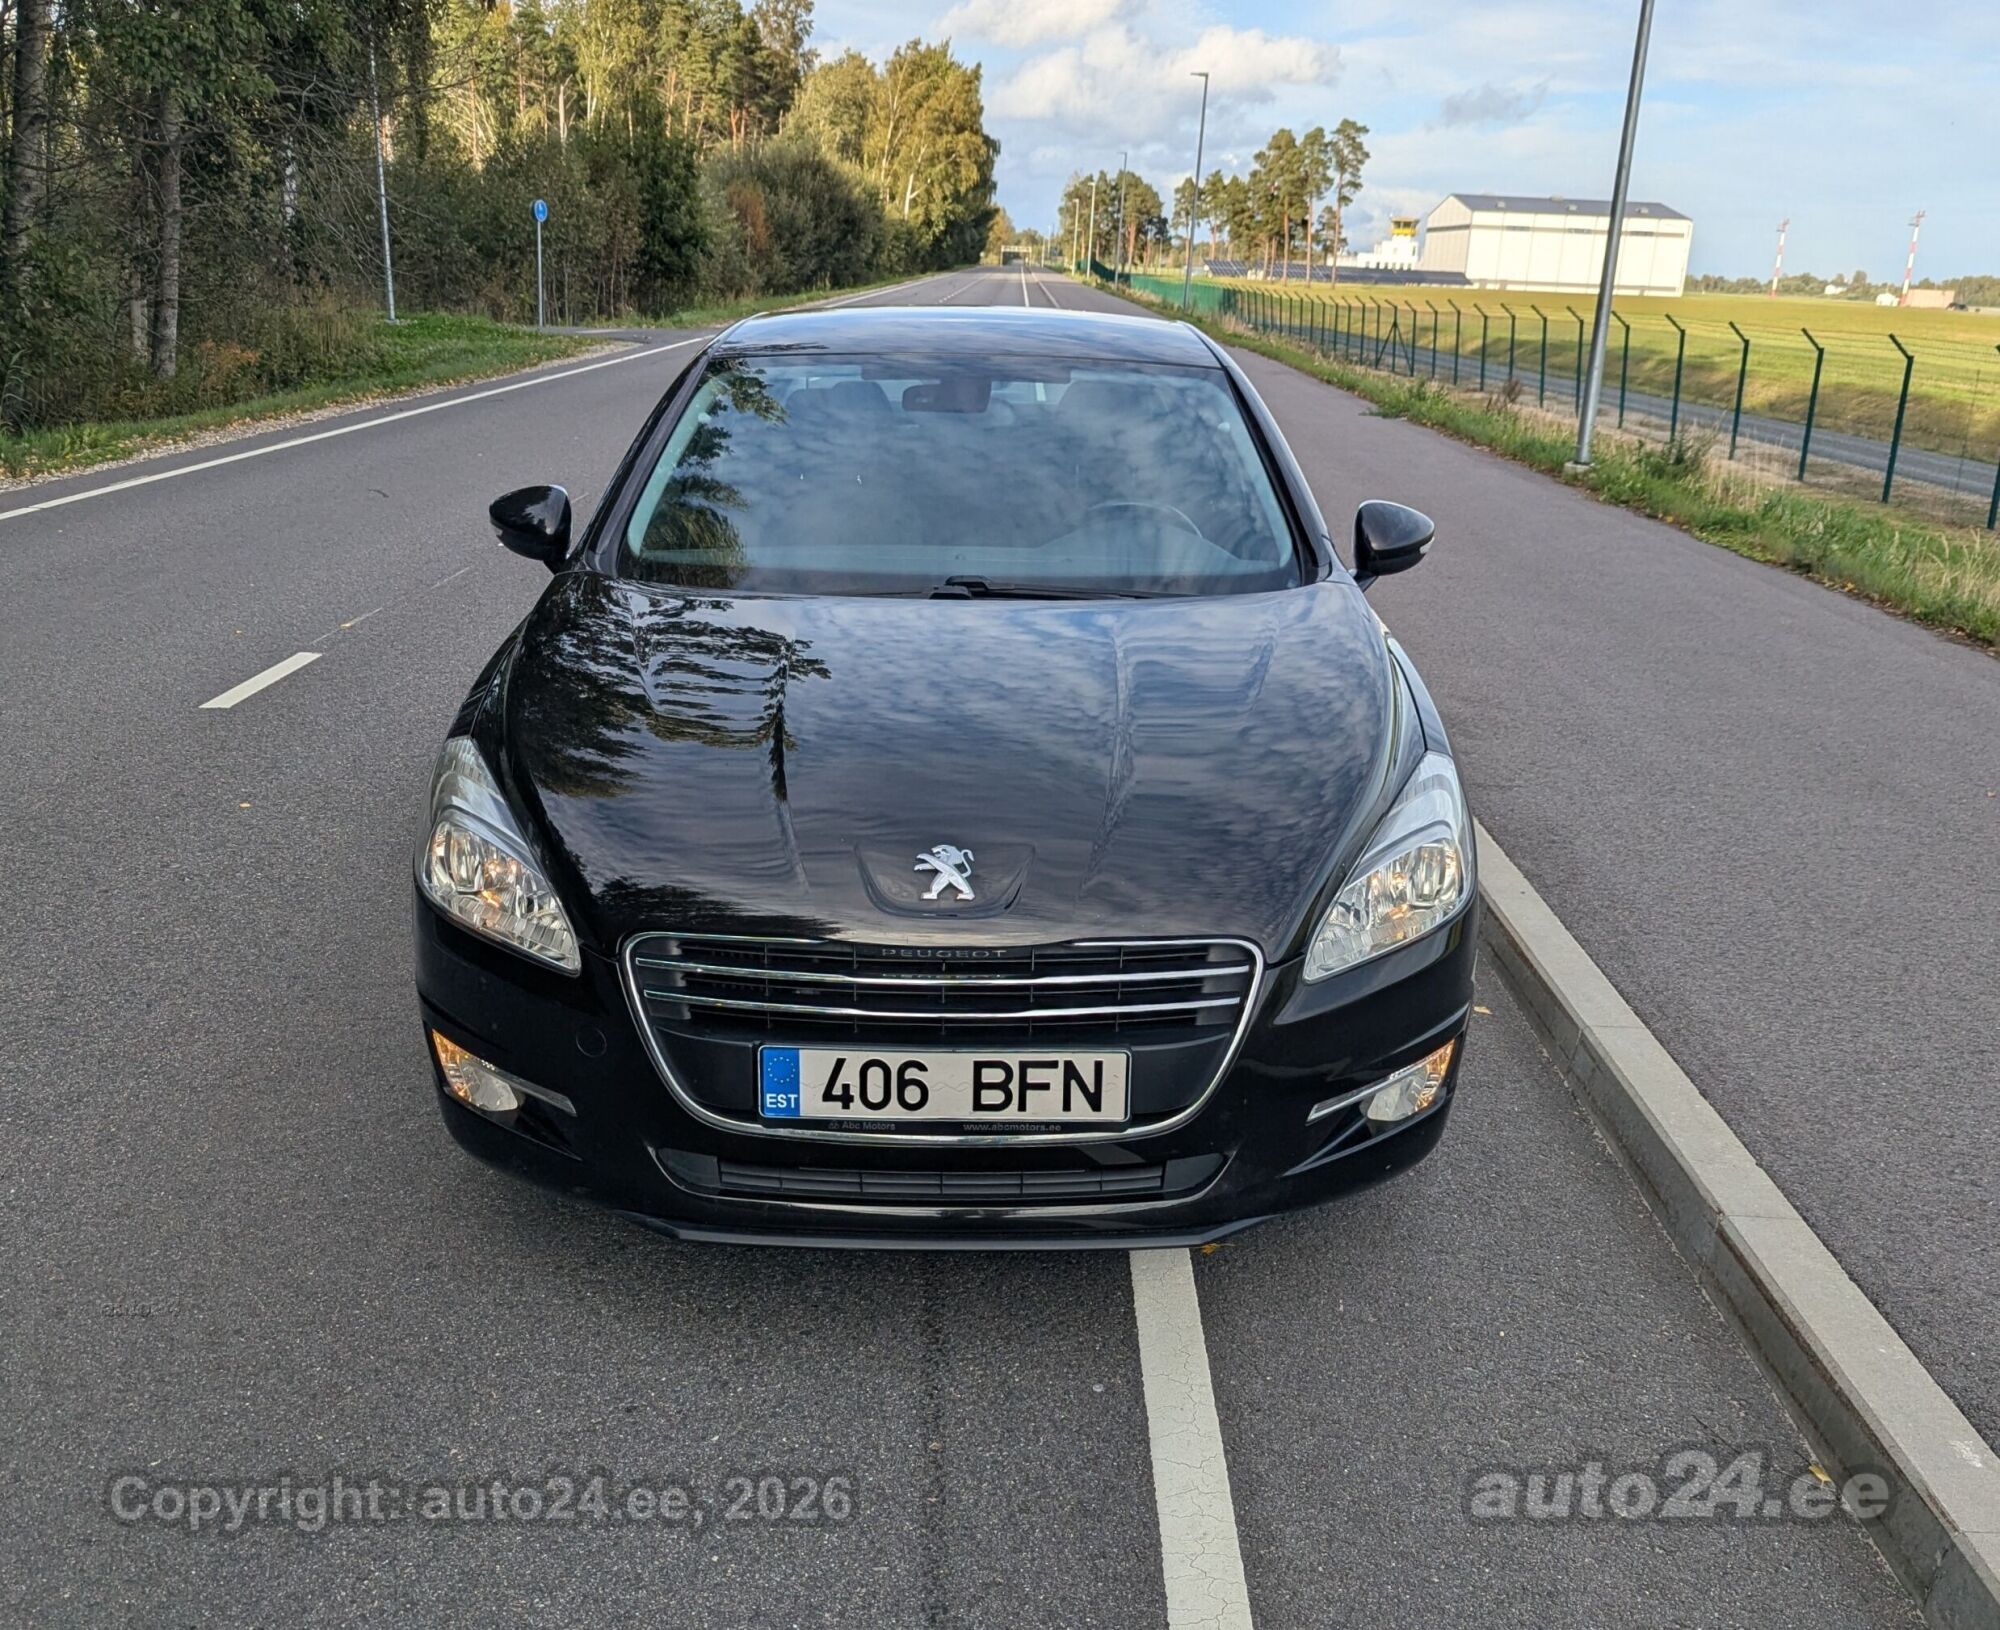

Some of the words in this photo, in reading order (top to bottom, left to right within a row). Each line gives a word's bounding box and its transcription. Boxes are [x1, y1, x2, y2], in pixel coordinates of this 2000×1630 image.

[881, 948, 1007, 958] PEUGEOT
[822, 1057, 929, 1111] 406
[972, 1059, 1103, 1113] BFN
[766, 1093, 798, 1109] EST
[841, 1120, 860, 1131] Abc
[862, 1121, 896, 1132] Motors
[962, 1121, 1062, 1132] www.abcmotors.ee
